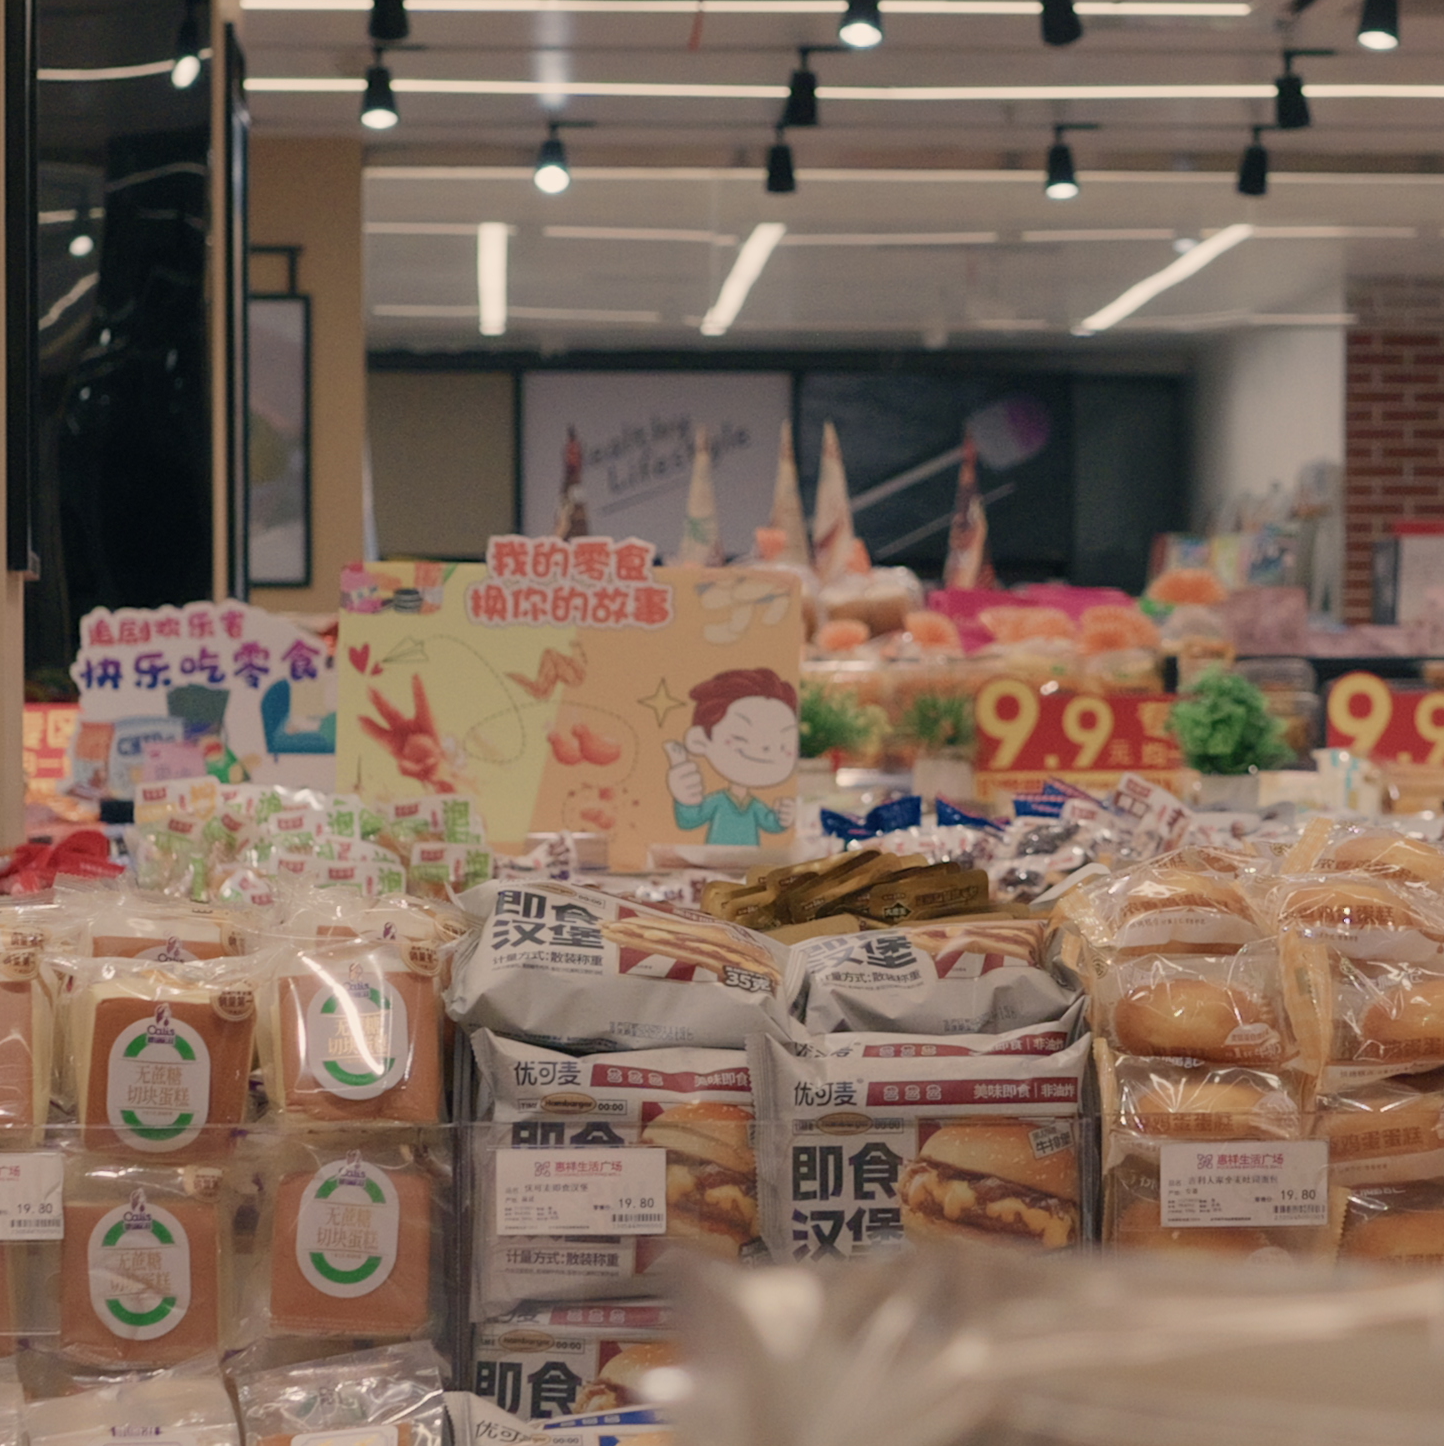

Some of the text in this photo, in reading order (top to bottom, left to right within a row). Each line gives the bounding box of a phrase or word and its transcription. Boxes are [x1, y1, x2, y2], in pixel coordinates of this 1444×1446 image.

[491, 538, 654, 583] 我的零食
[469, 585, 673, 626] 换你的故事
[79, 639, 322, 690] 快乐吃零食
[977, 678, 1114, 772] 9.9
[494, 889, 603, 926] 即食
[491, 918, 605, 950] 汉堡
[725, 970, 770, 993] 35克
[146, 1024, 176, 1036] Calis
[135, 1065, 184, 1086] 无蔗糖
[513, 1060, 750, 1089] 优可麦 美味即食
[127, 1085, 191, 1108] 切块蛋糕
[793, 1080, 1075, 1108] 优可麦 美味即食 非油炸
[597, 1102, 625, 1112] 00:00
[554, 1160, 623, 1173] 惠祥生活广场
[1216, 1153, 1284, 1166] 惠祥生活广场
[791, 1142, 904, 1202] 即食
[618, 1197, 655, 1209] 19.80
[1280, 1189, 1317, 1201] 19.80
[16, 1203, 54, 1215] 19.80
[323, 1206, 373, 1229] 无蔗糖
[315, 1225, 380, 1251] 切块蛋糕
[791, 1206, 905, 1267] 汉堡
[506, 1249, 620, 1268] 计量方式:散装称重
[474, 1360, 583, 1421] 即食
